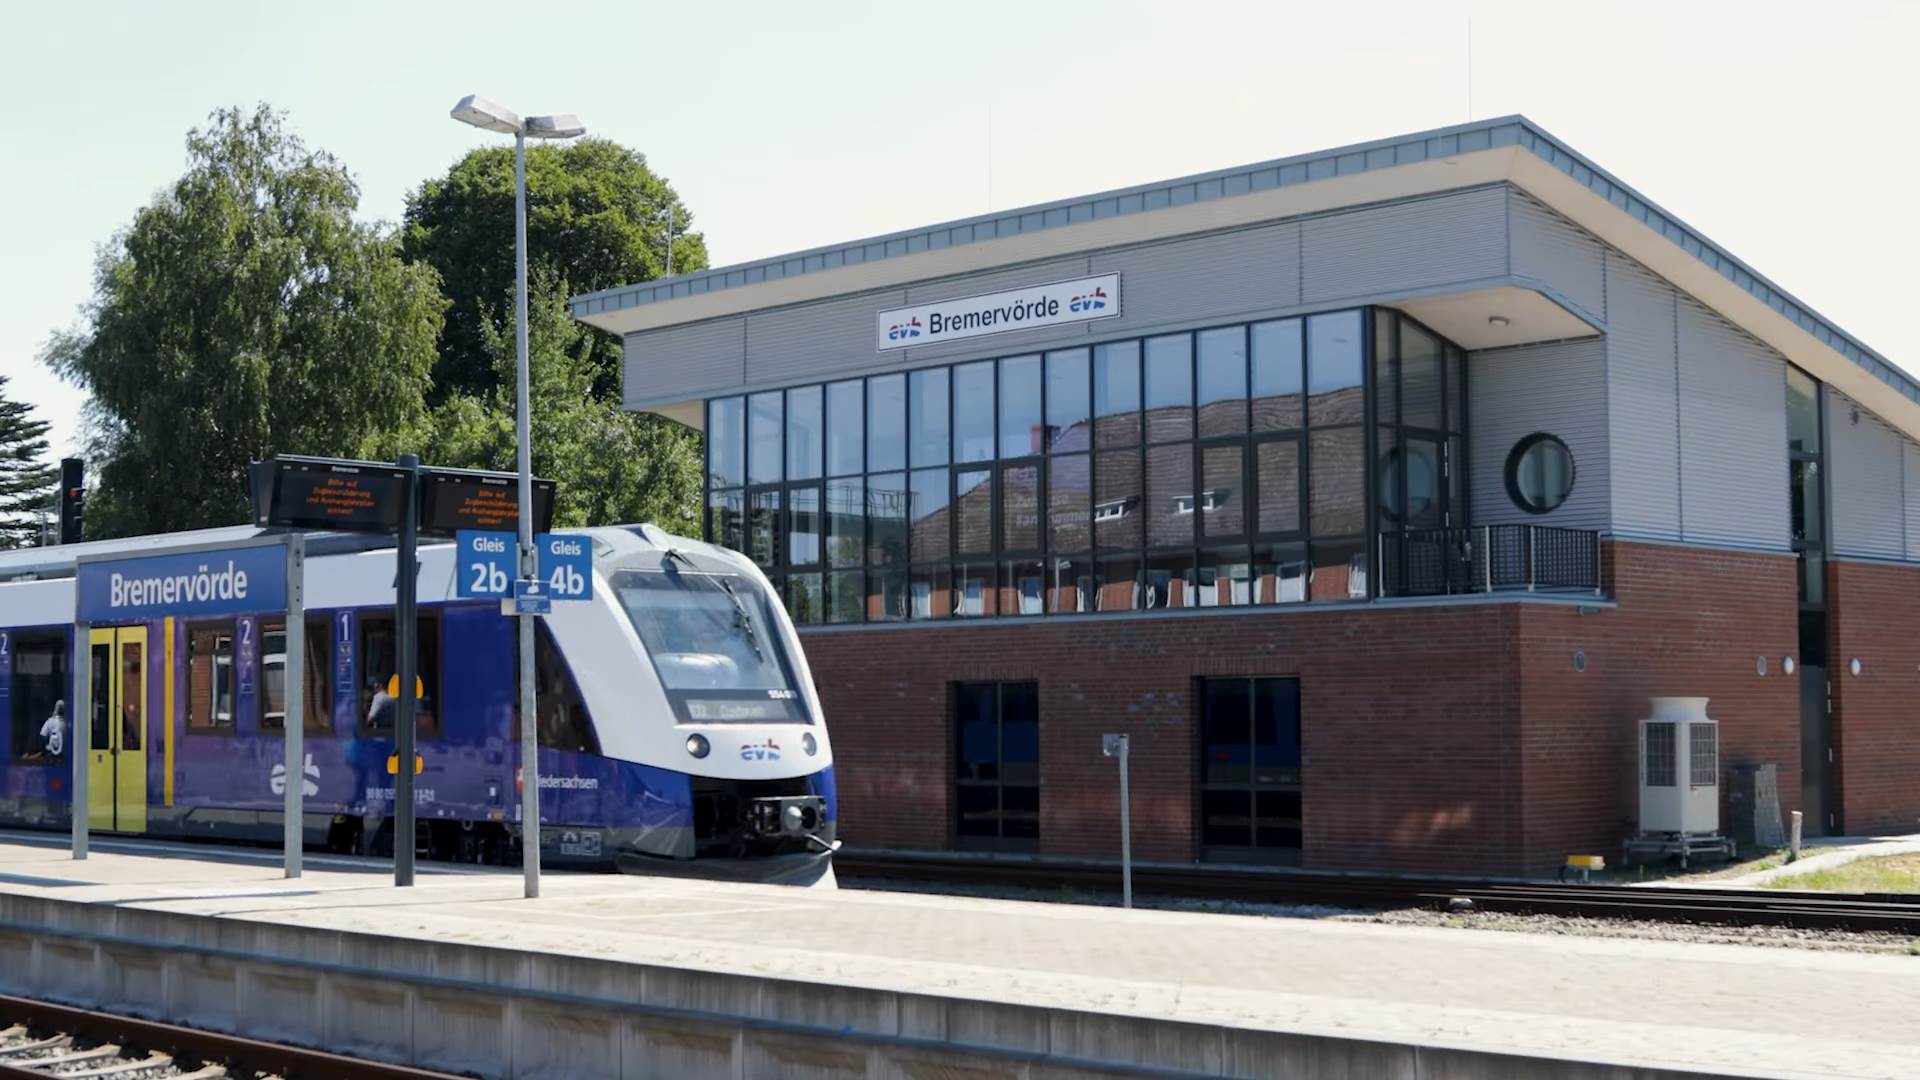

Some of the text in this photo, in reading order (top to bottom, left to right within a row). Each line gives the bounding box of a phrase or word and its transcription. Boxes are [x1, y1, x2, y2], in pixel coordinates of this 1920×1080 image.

[929, 296, 1059, 334] Bremervörde
[472, 537, 505, 552] Gleis
[550, 541, 581, 556] Gleis
[110, 560, 248, 608] Bremervörde
[470, 562, 508, 593] 2b
[550, 565, 584, 595] 4b
[241, 620, 251, 645] 2
[341, 613, 349, 641] 1
[0, 633, 8, 655] 2
[537, 774, 598, 789] iedersachsen
